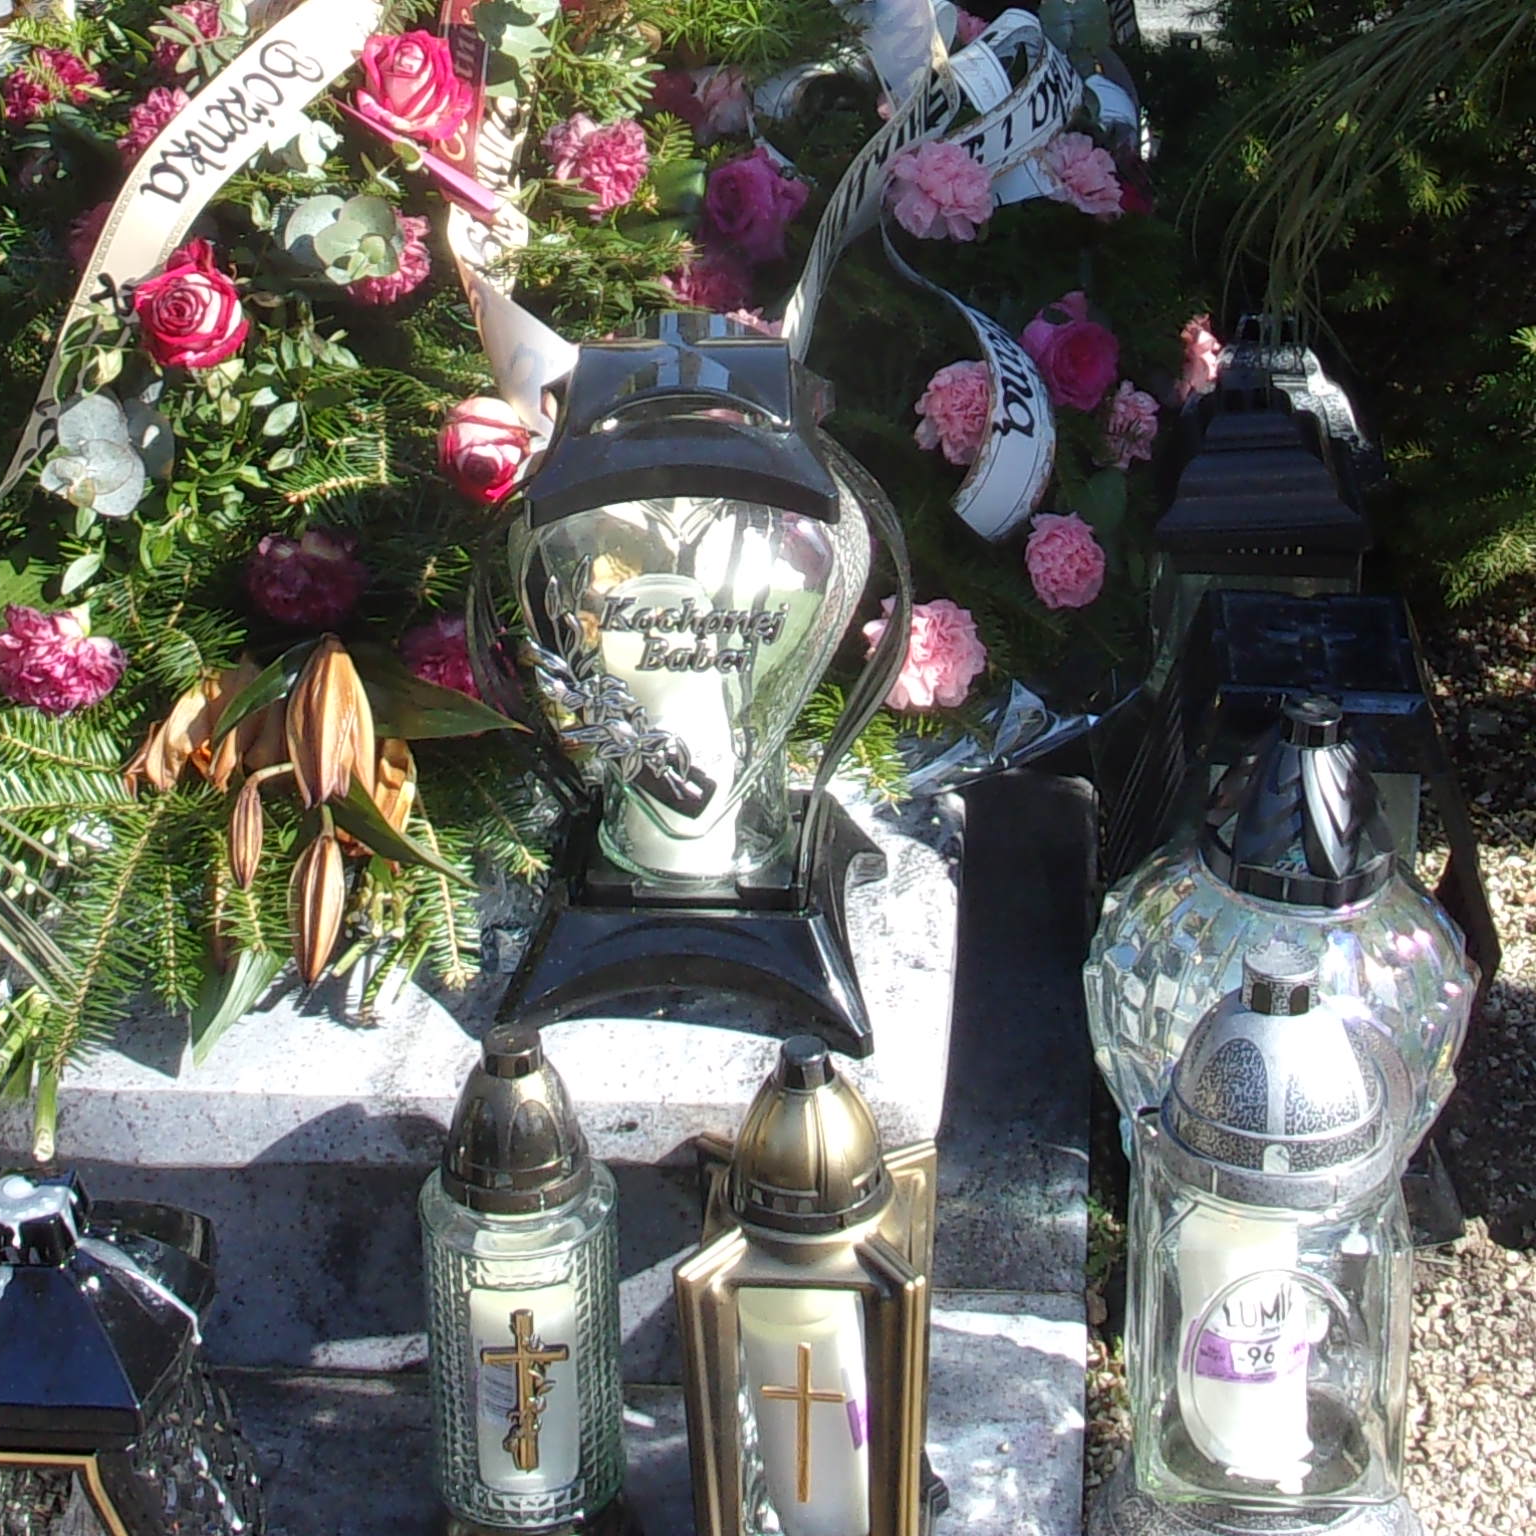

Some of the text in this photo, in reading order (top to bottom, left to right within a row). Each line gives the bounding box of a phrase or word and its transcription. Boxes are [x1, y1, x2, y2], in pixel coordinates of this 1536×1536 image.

[140, 39, 324, 204] Bożenka
[597, 595, 791, 646] Kochanej
[635, 636, 753, 672] Babci
